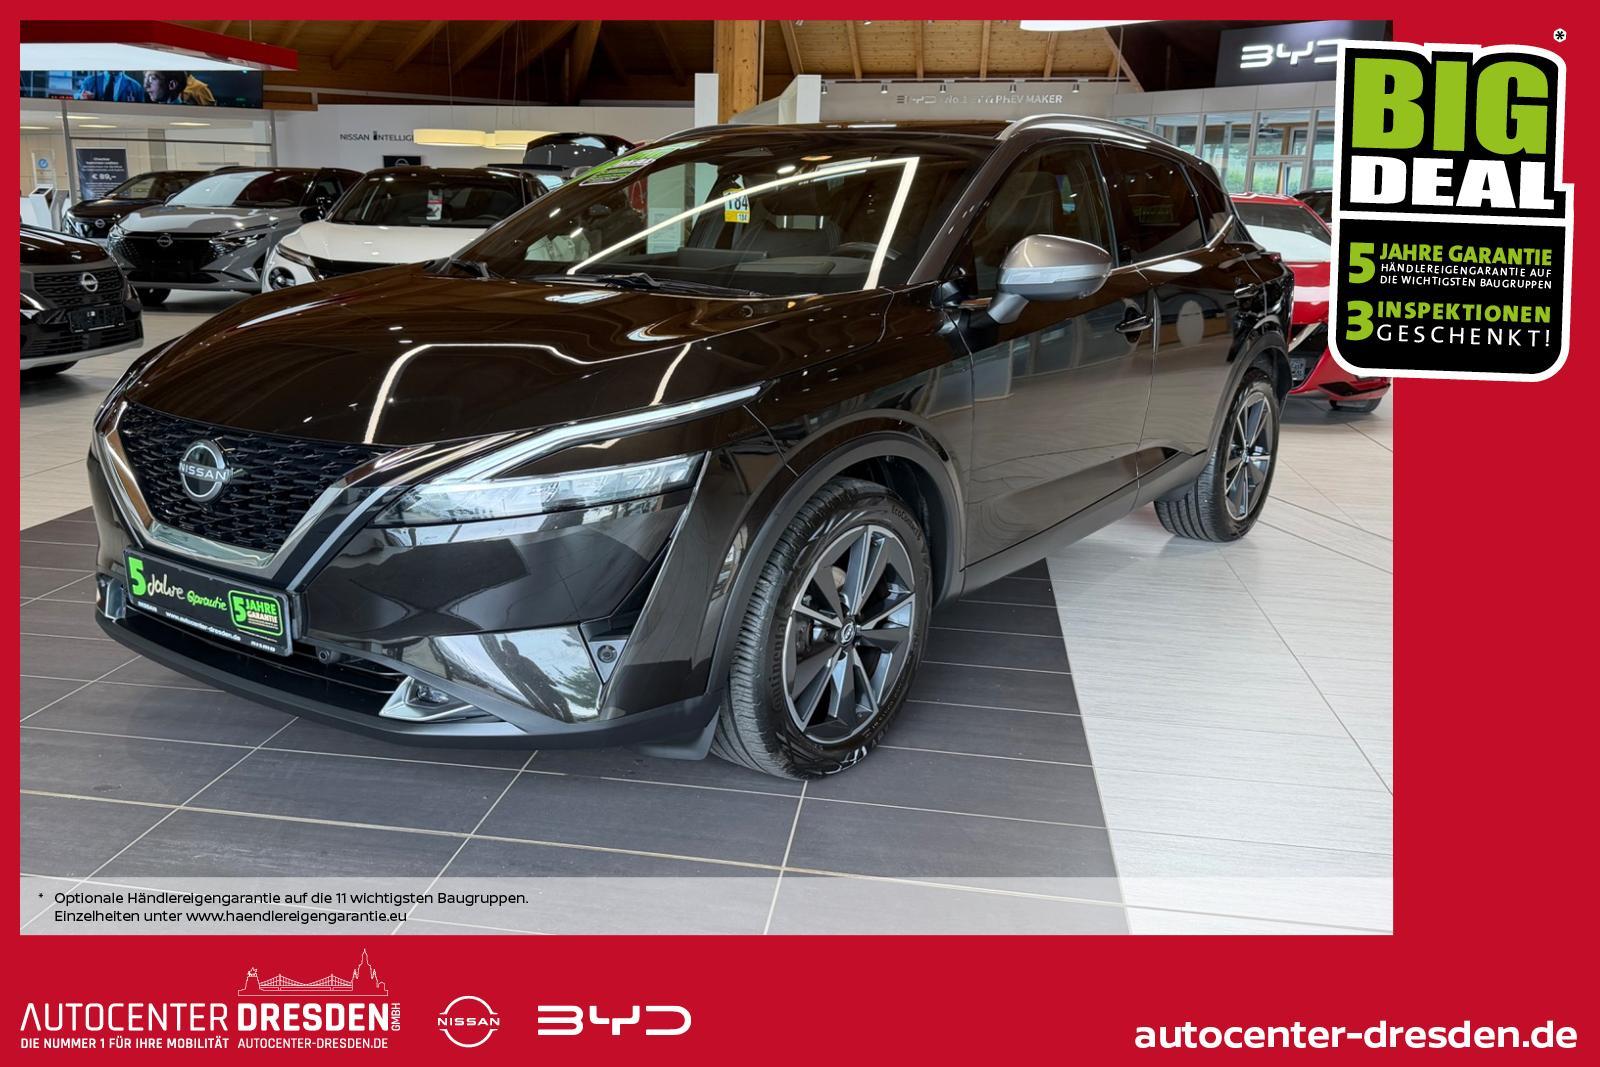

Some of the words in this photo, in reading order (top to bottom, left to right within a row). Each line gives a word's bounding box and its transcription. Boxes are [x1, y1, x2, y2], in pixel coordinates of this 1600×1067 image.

[1025, 94, 1063, 104] MAKER
[340, 133, 370, 141] NISSAN
[179, 462, 227, 480] NISSAN
[128, 557, 146, 596] 5
[232, 596, 247, 622] 5
[246, 599, 277, 616] JAHRE
